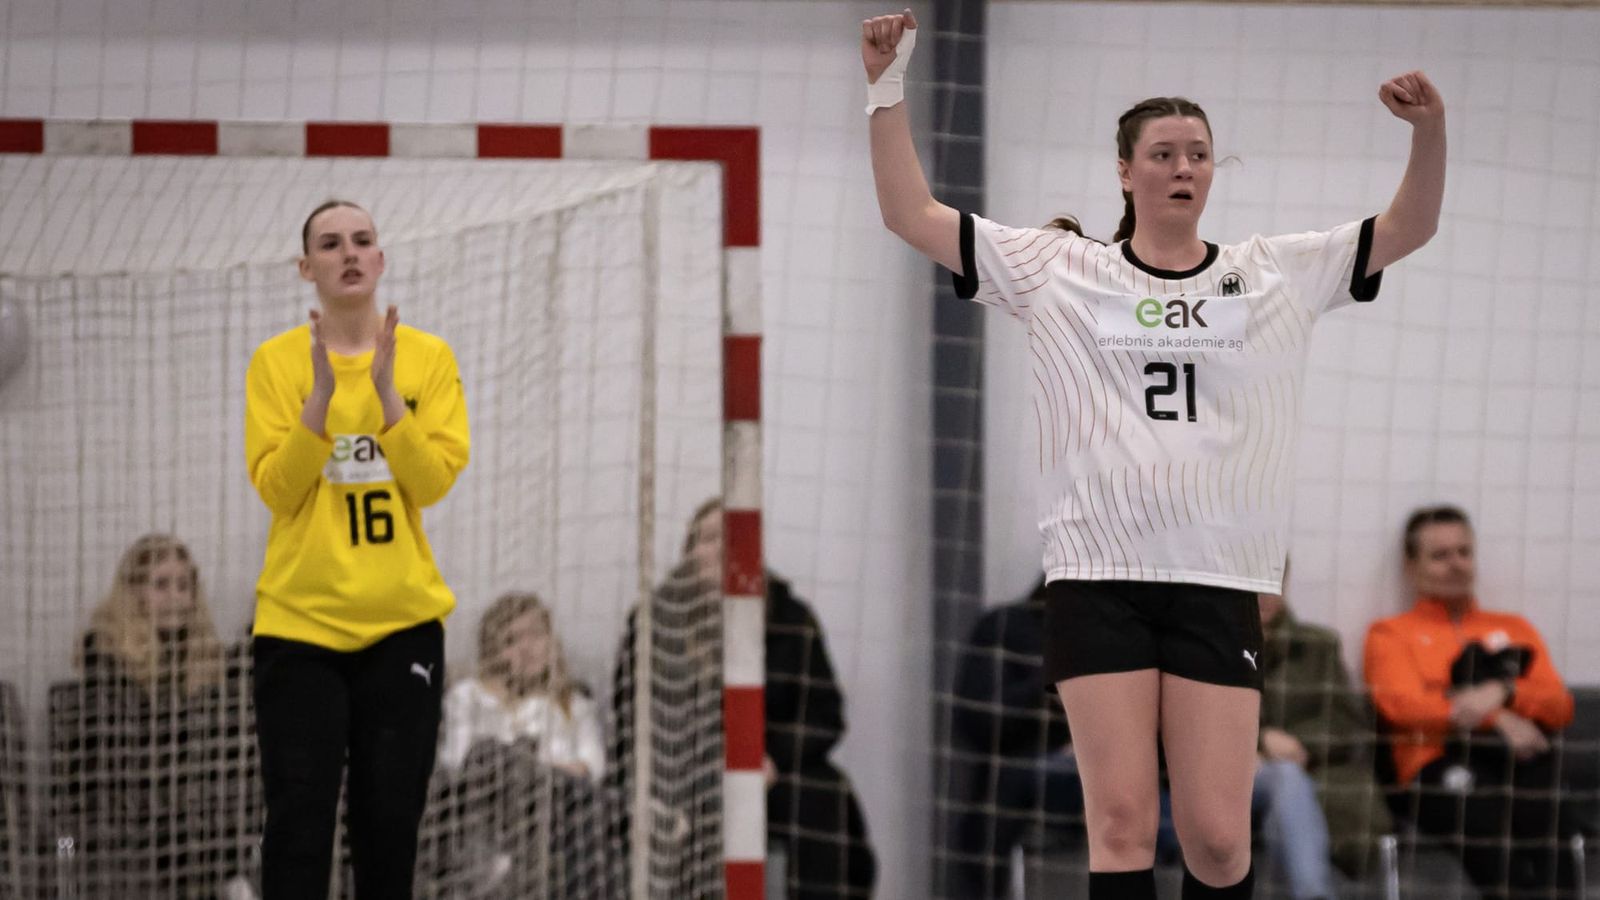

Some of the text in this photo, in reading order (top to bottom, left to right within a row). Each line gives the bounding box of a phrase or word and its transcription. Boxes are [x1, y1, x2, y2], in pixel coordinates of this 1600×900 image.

[1099, 335, 1244, 351] erlebnis akademie ag
[1143, 361, 1198, 423] 21
[345, 490, 394, 546] 16
